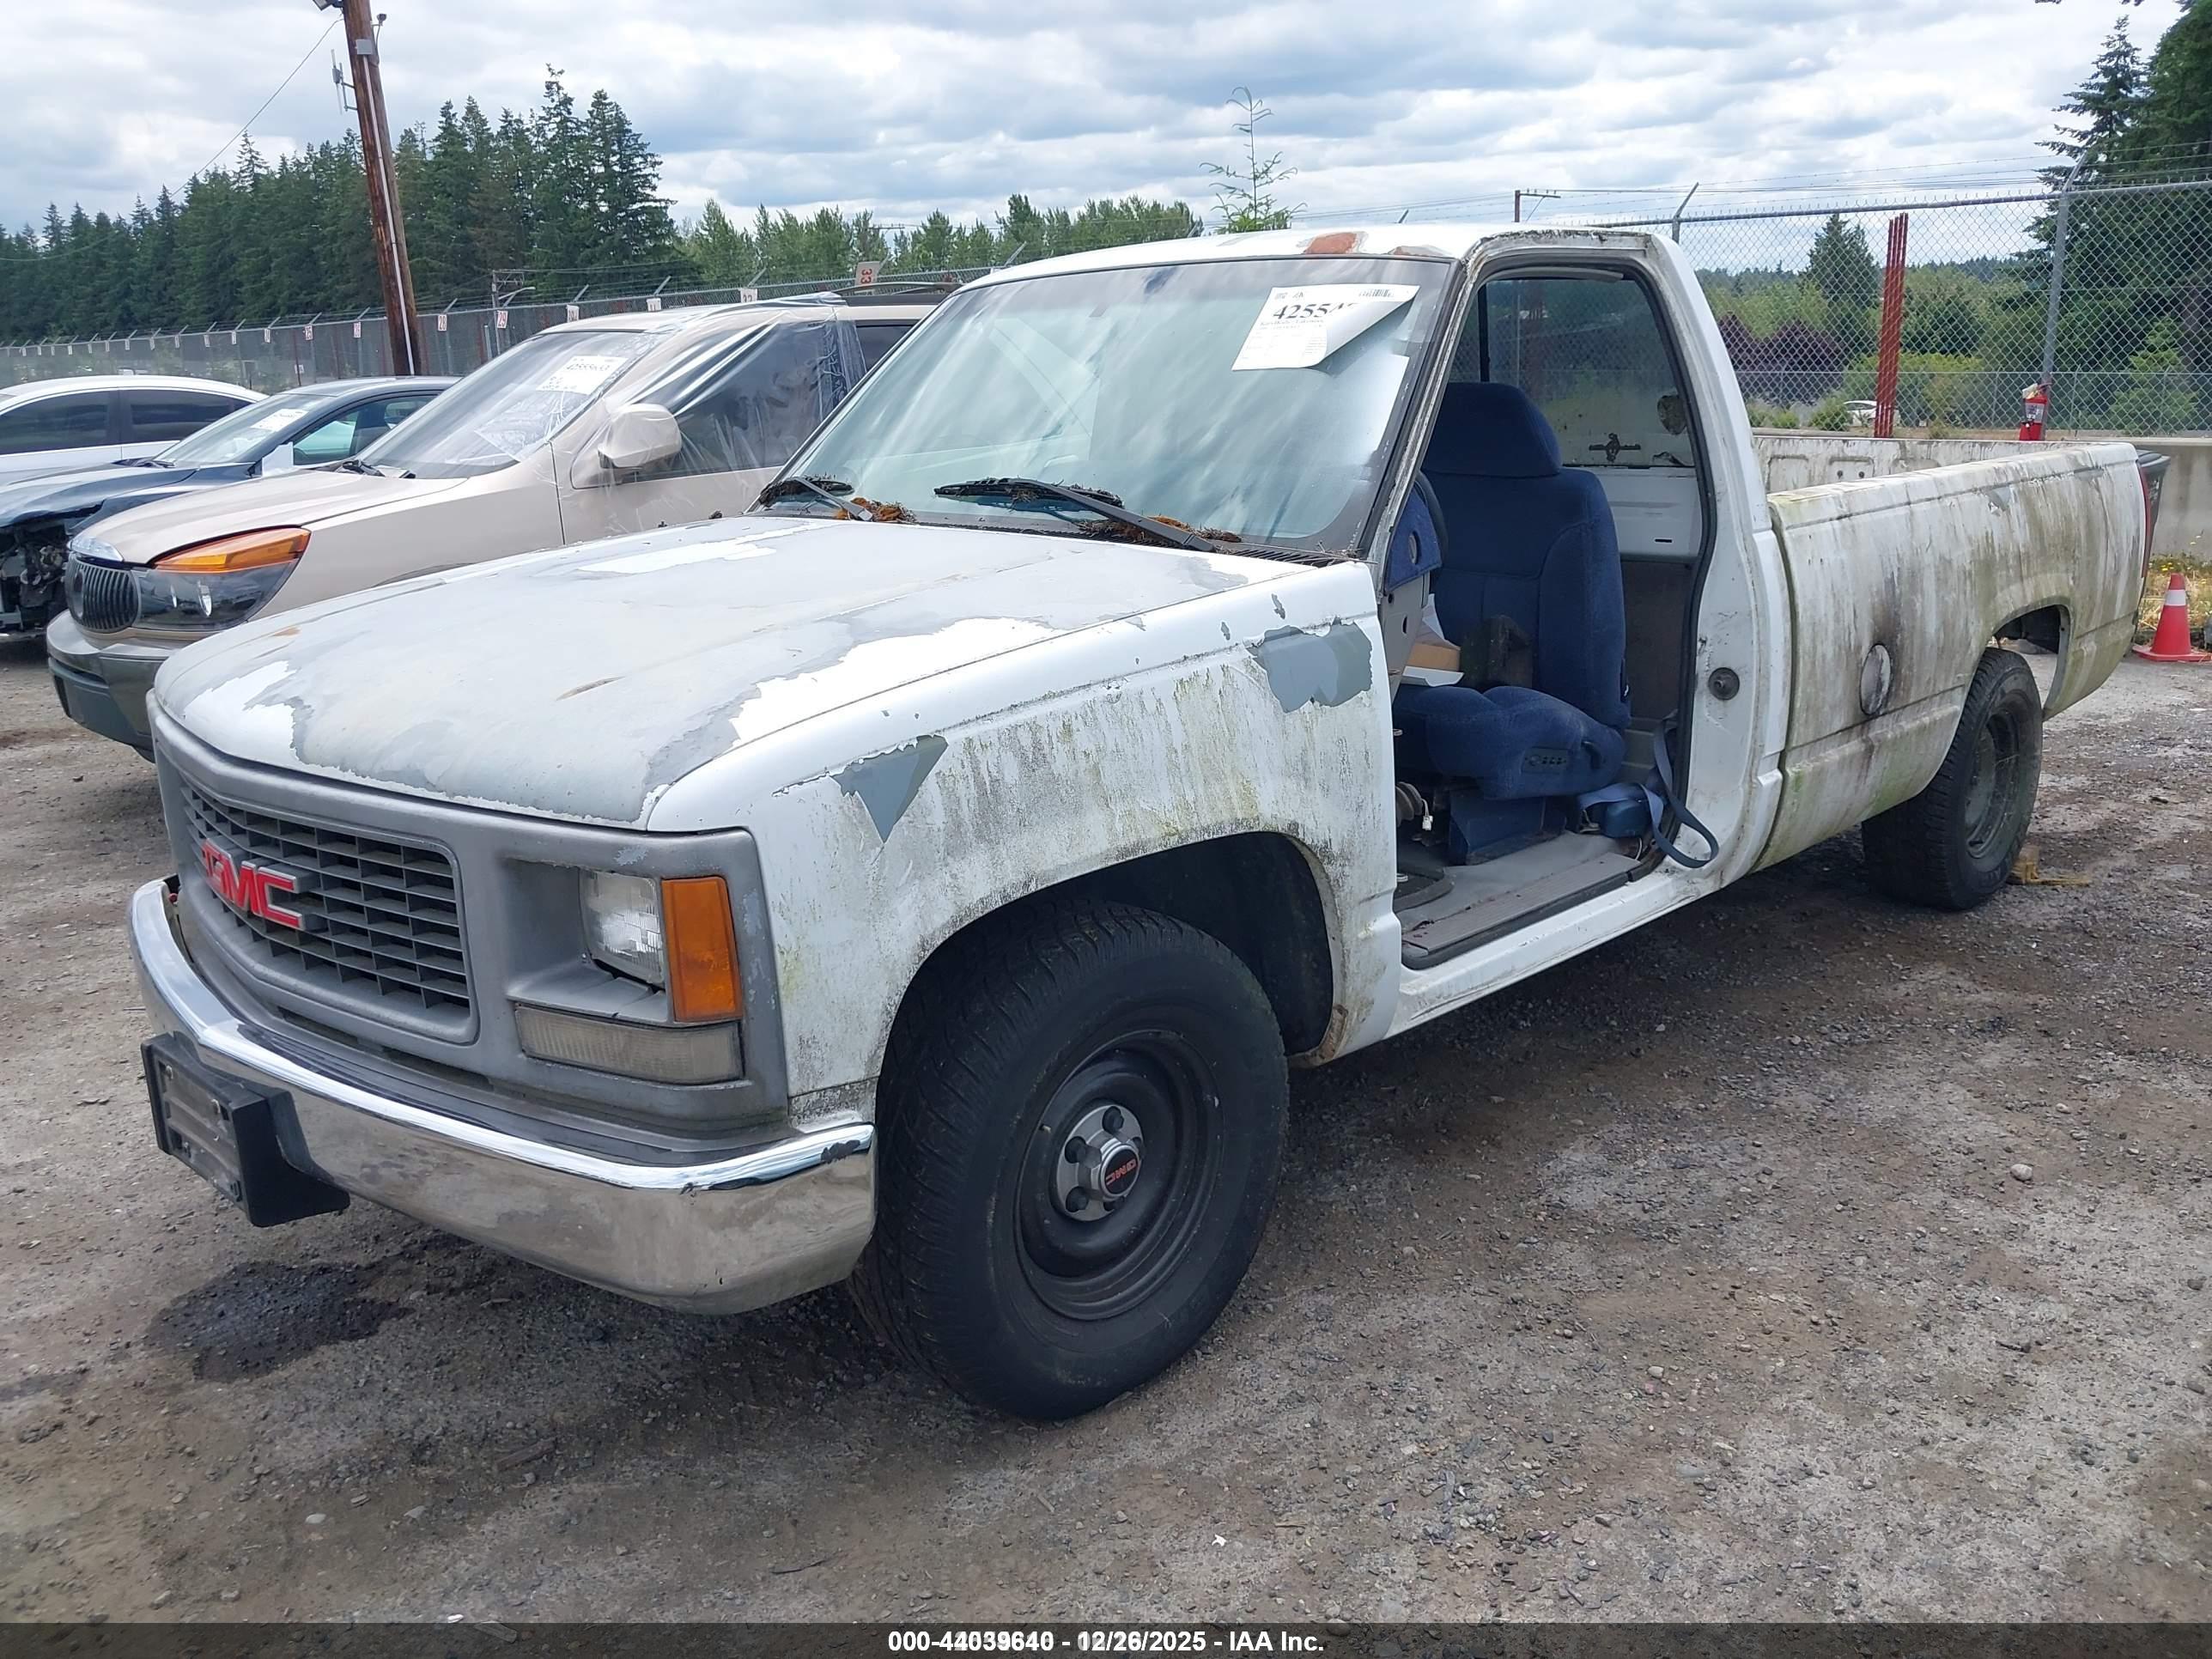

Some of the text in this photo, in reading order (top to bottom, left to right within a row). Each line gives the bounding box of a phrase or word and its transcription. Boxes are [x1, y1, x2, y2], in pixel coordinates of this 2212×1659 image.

[1273, 302, 1357, 319] 4255
[201, 838, 303, 931] GMC
[1105, 1158, 1137, 1186] GMC
